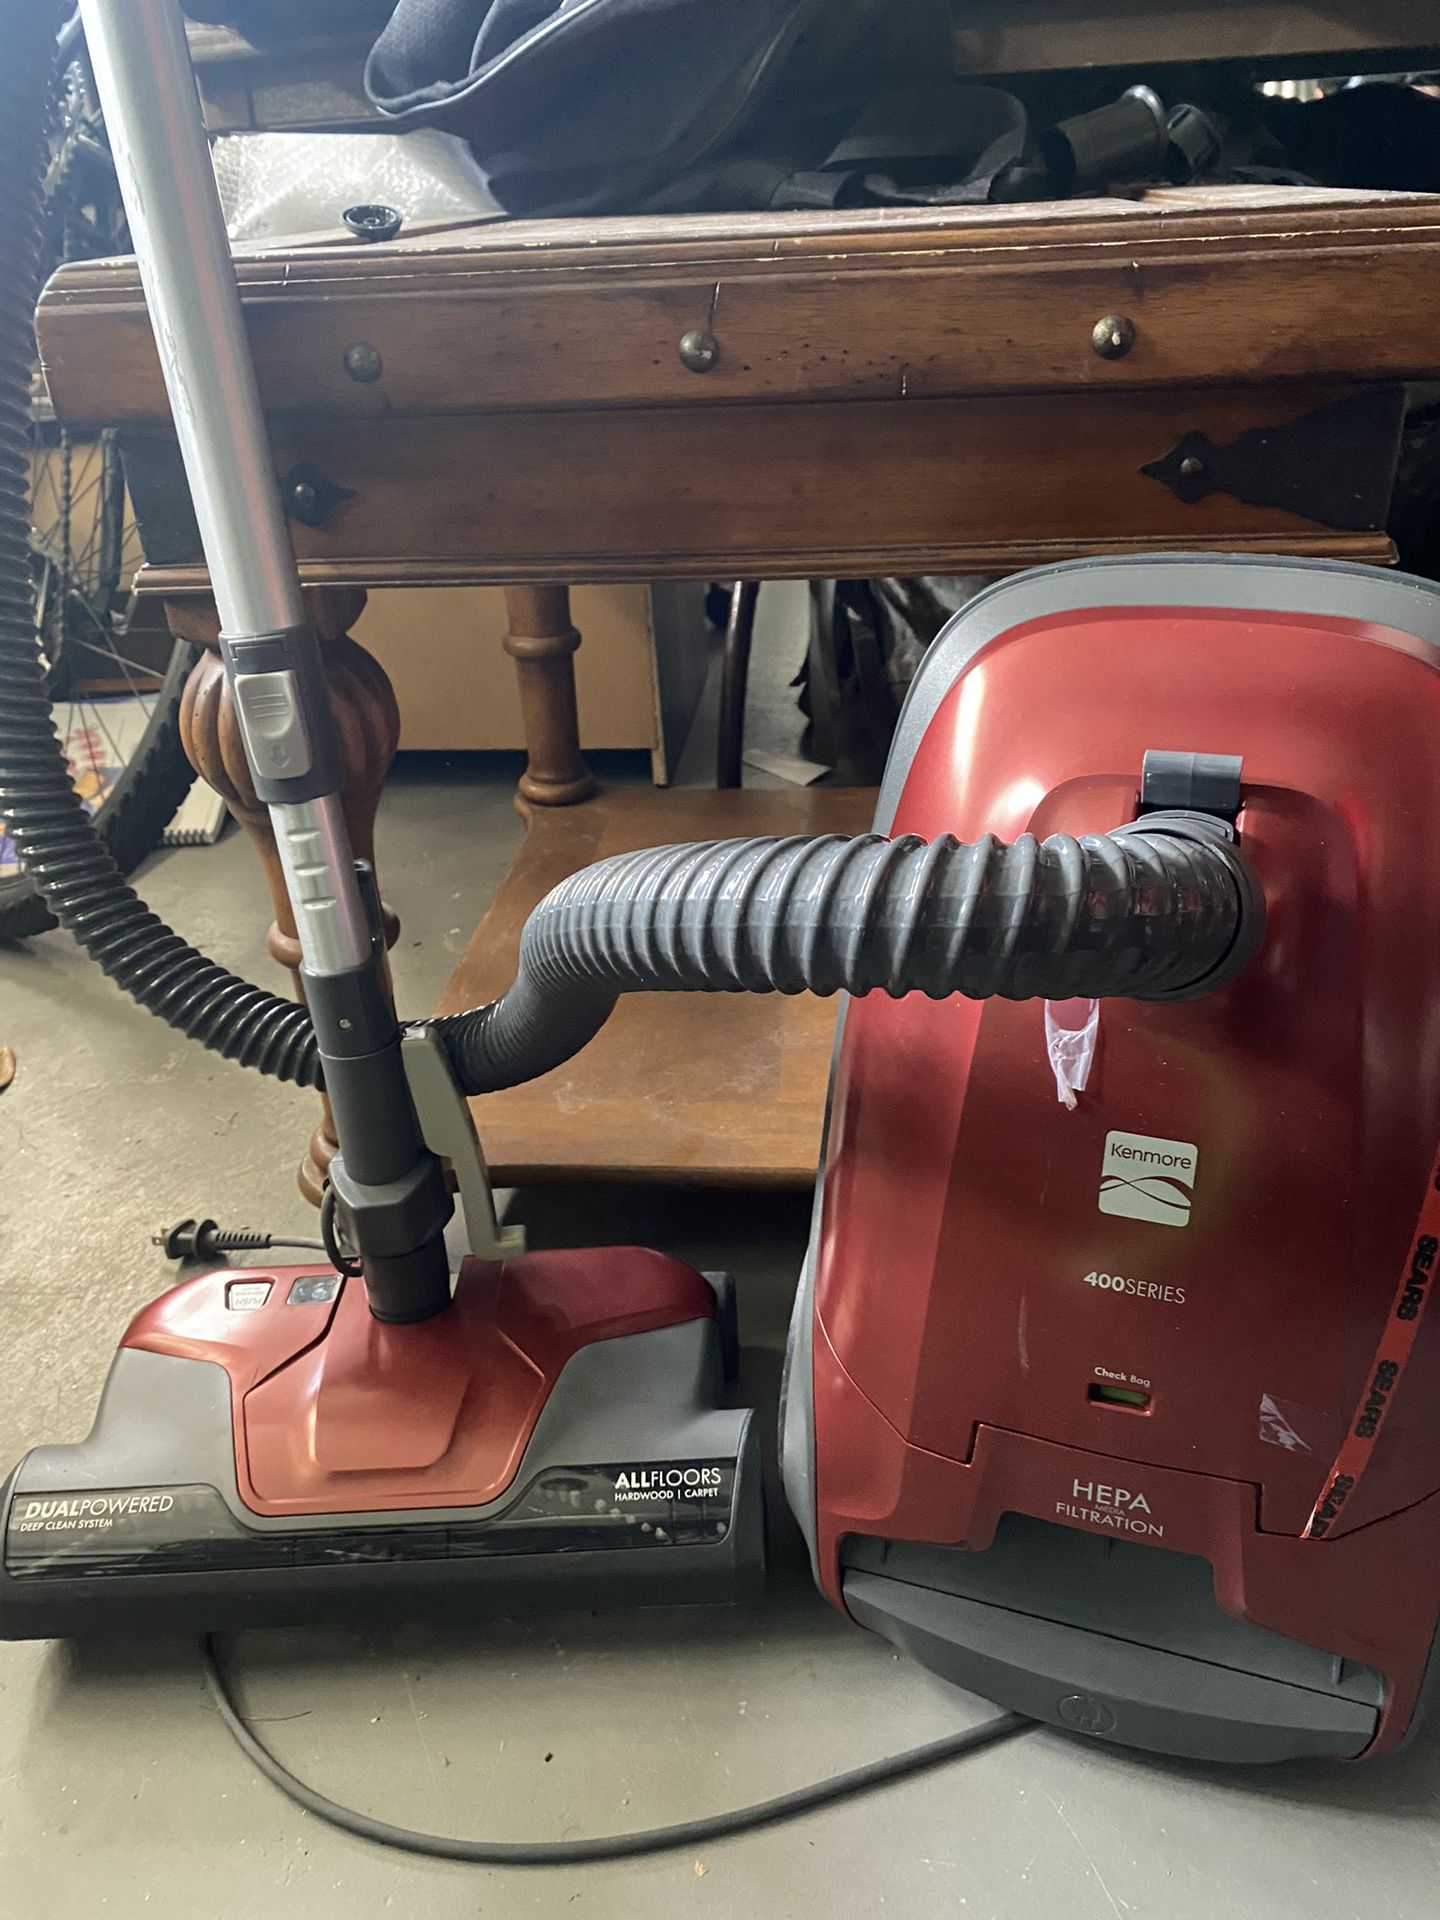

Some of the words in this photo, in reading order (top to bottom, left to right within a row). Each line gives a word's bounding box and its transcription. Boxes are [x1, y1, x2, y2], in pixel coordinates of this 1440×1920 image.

[1111, 1143, 1192, 1169] Kenmore
[1083, 1271, 1186, 1304] 400SERIES
[1396, 1233, 1439, 1321] SEARS
[1094, 1366, 1127, 1381] Check
[1130, 1374, 1151, 1388] Bag
[1355, 1359, 1399, 1438] SEARS
[614, 1467, 722, 1489] ALLFLOORS
[24, 1495, 174, 1519] DUALPOWERED
[614, 1489, 674, 1502] HARDWOOD
[684, 1487, 719, 1499] CARPET
[1072, 1478, 1151, 1514] HEPA
[1056, 1501, 1164, 1537] FILTRATION
[1094, 1503, 1126, 1516] MEDIA
[20, 1522, 44, 1532] DEEP
[45, 1520, 76, 1530] CLEAN
[78, 1518, 113, 1529] SYSTEM
